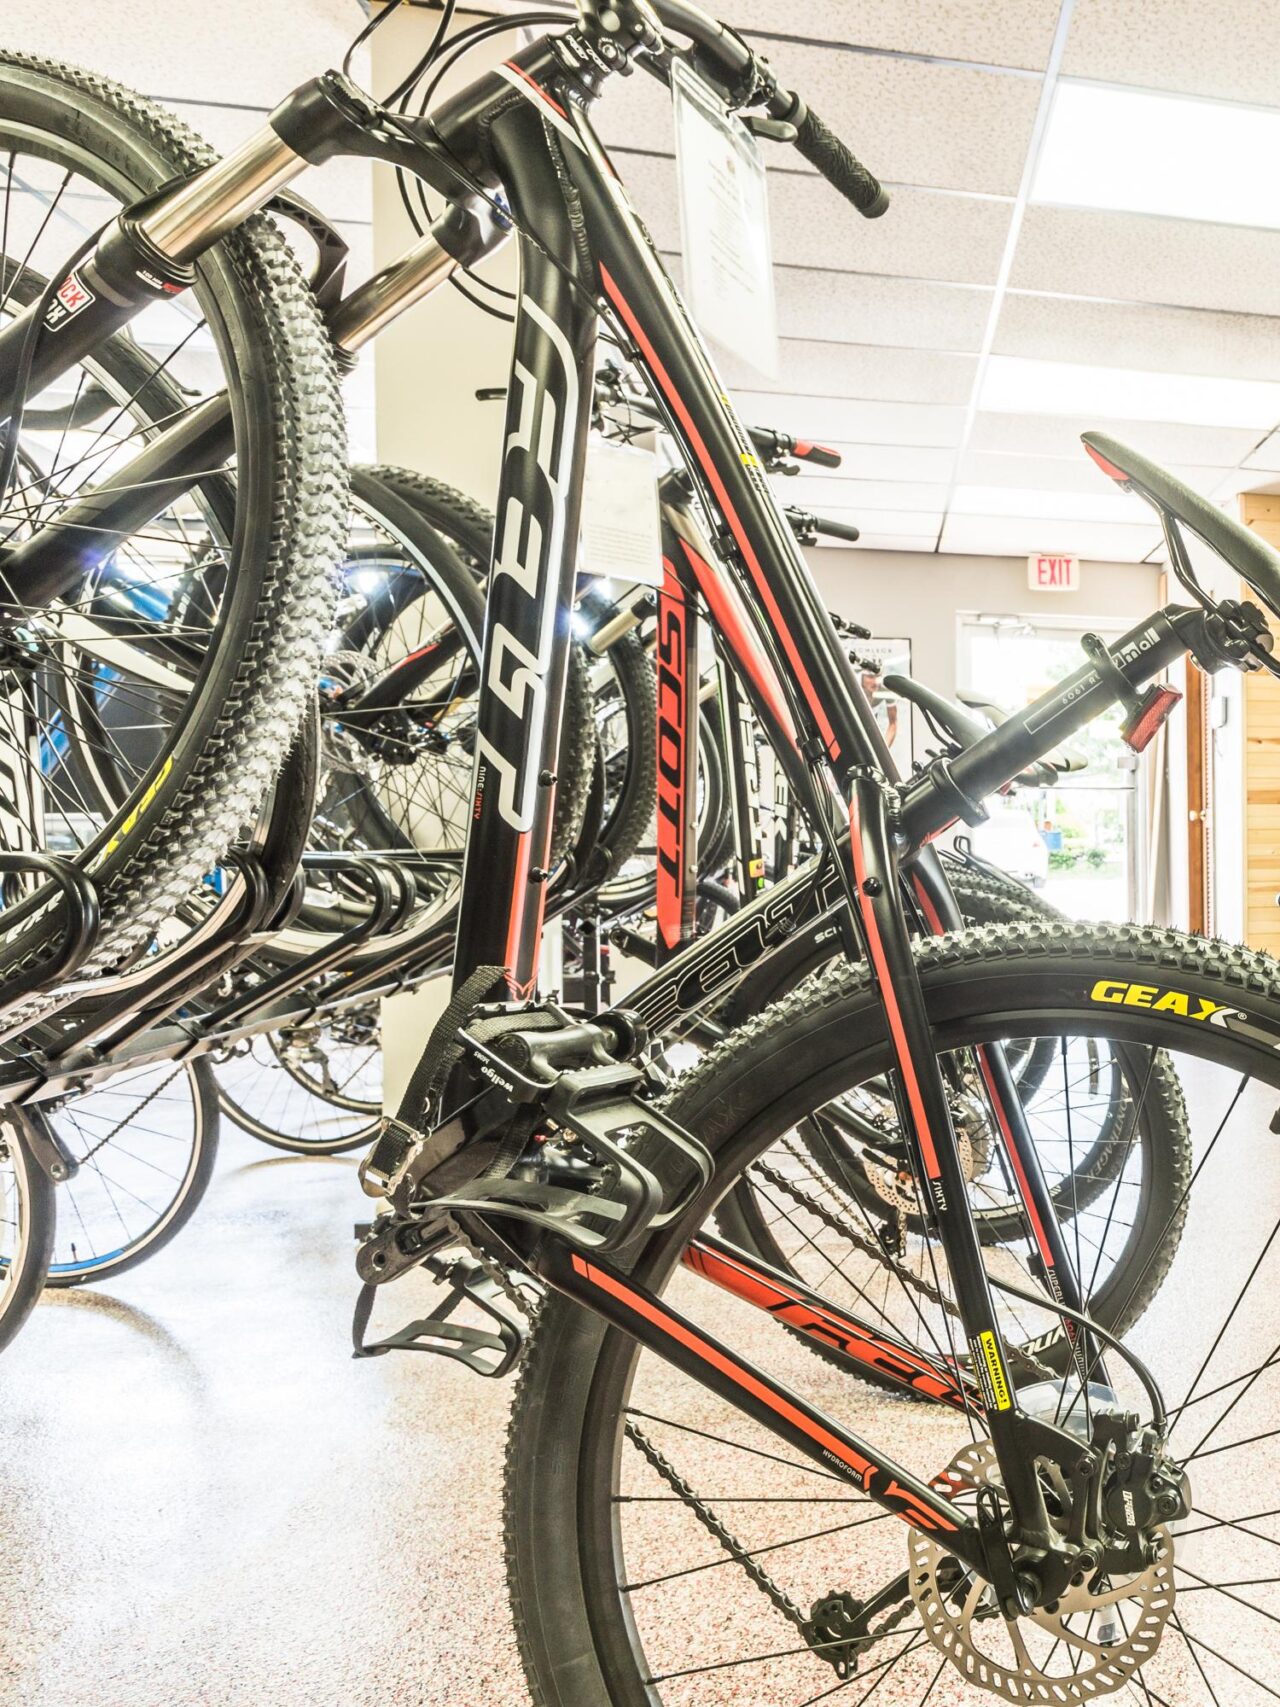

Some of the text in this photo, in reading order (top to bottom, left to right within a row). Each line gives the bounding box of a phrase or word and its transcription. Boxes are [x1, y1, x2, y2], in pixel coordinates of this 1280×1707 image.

[1037, 558, 1072, 585] EXIT
[658, 609, 682, 899] SCOTT
[1090, 980, 1240, 1029] GEAX
[480, 1066, 514, 1093] wellgo
[932, 1180, 948, 1211] SIXTY
[985, 1337, 1008, 1404] WARNING!
[822, 1449, 864, 1483] HYDROFORM
